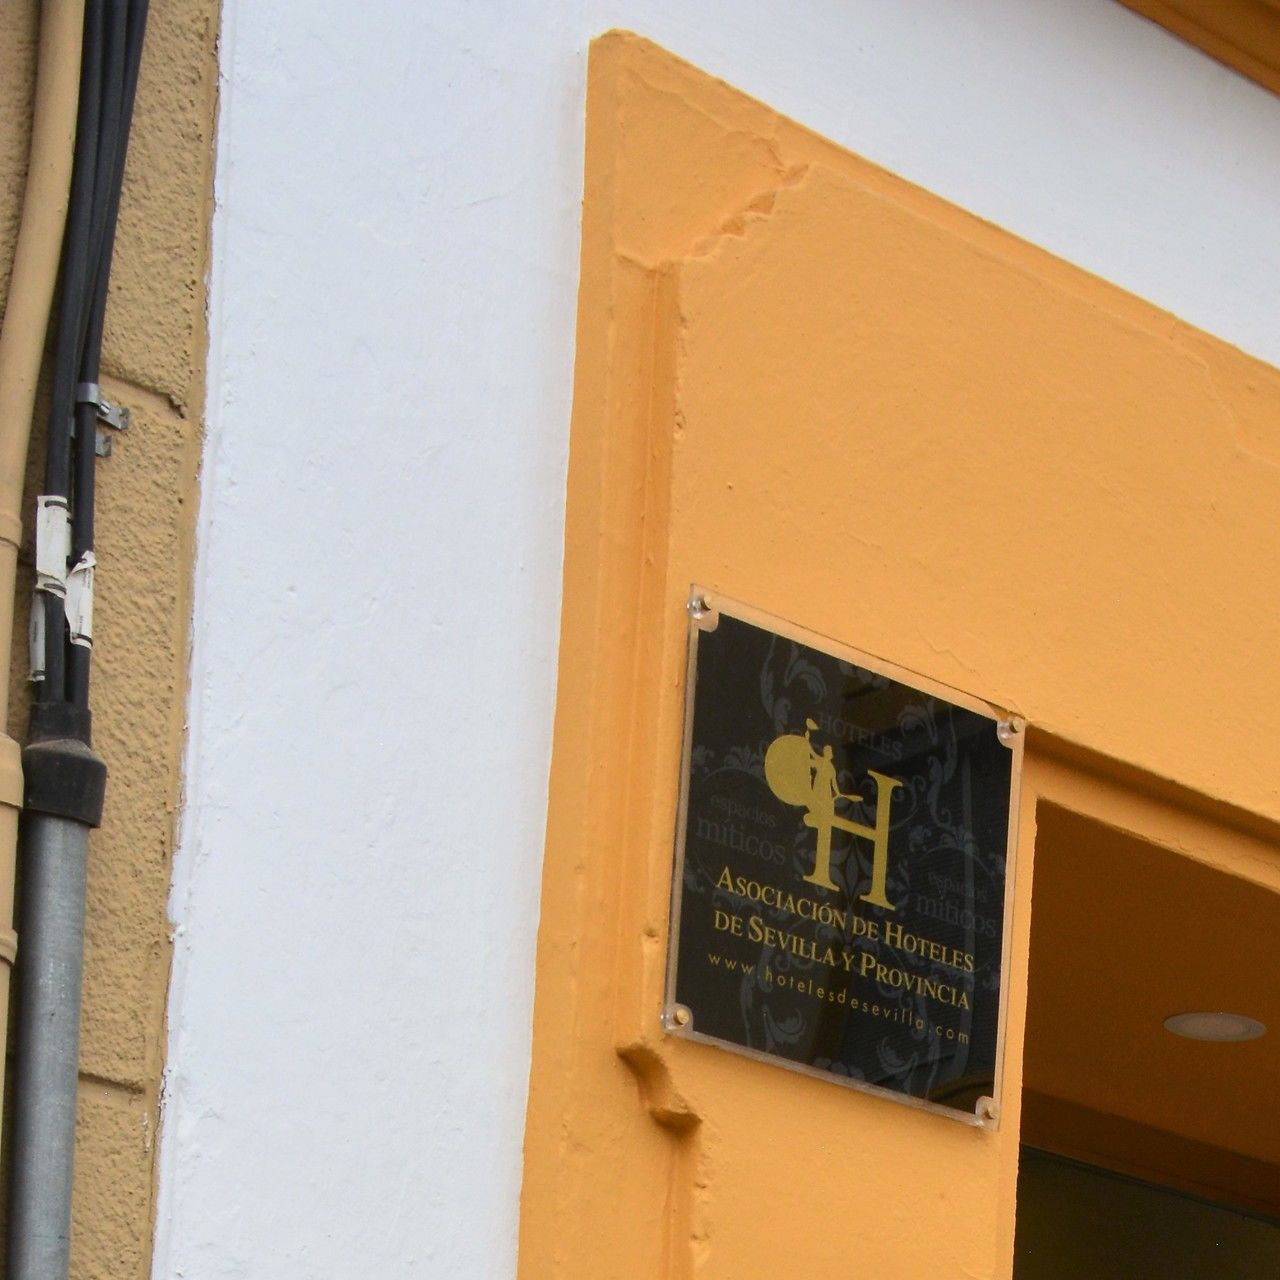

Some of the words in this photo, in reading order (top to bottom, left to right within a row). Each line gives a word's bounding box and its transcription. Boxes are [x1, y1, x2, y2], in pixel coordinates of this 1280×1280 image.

[818, 710, 902, 758] HOTELES
[714, 909, 744, 937] DE
[748, 914, 836, 968] SEVILLA
[840, 953, 855, 973] Y
[860, 952, 971, 1011] PROVINCIA
[852, 915, 880, 942] DE
[883, 920, 975, 974] HOTELES
